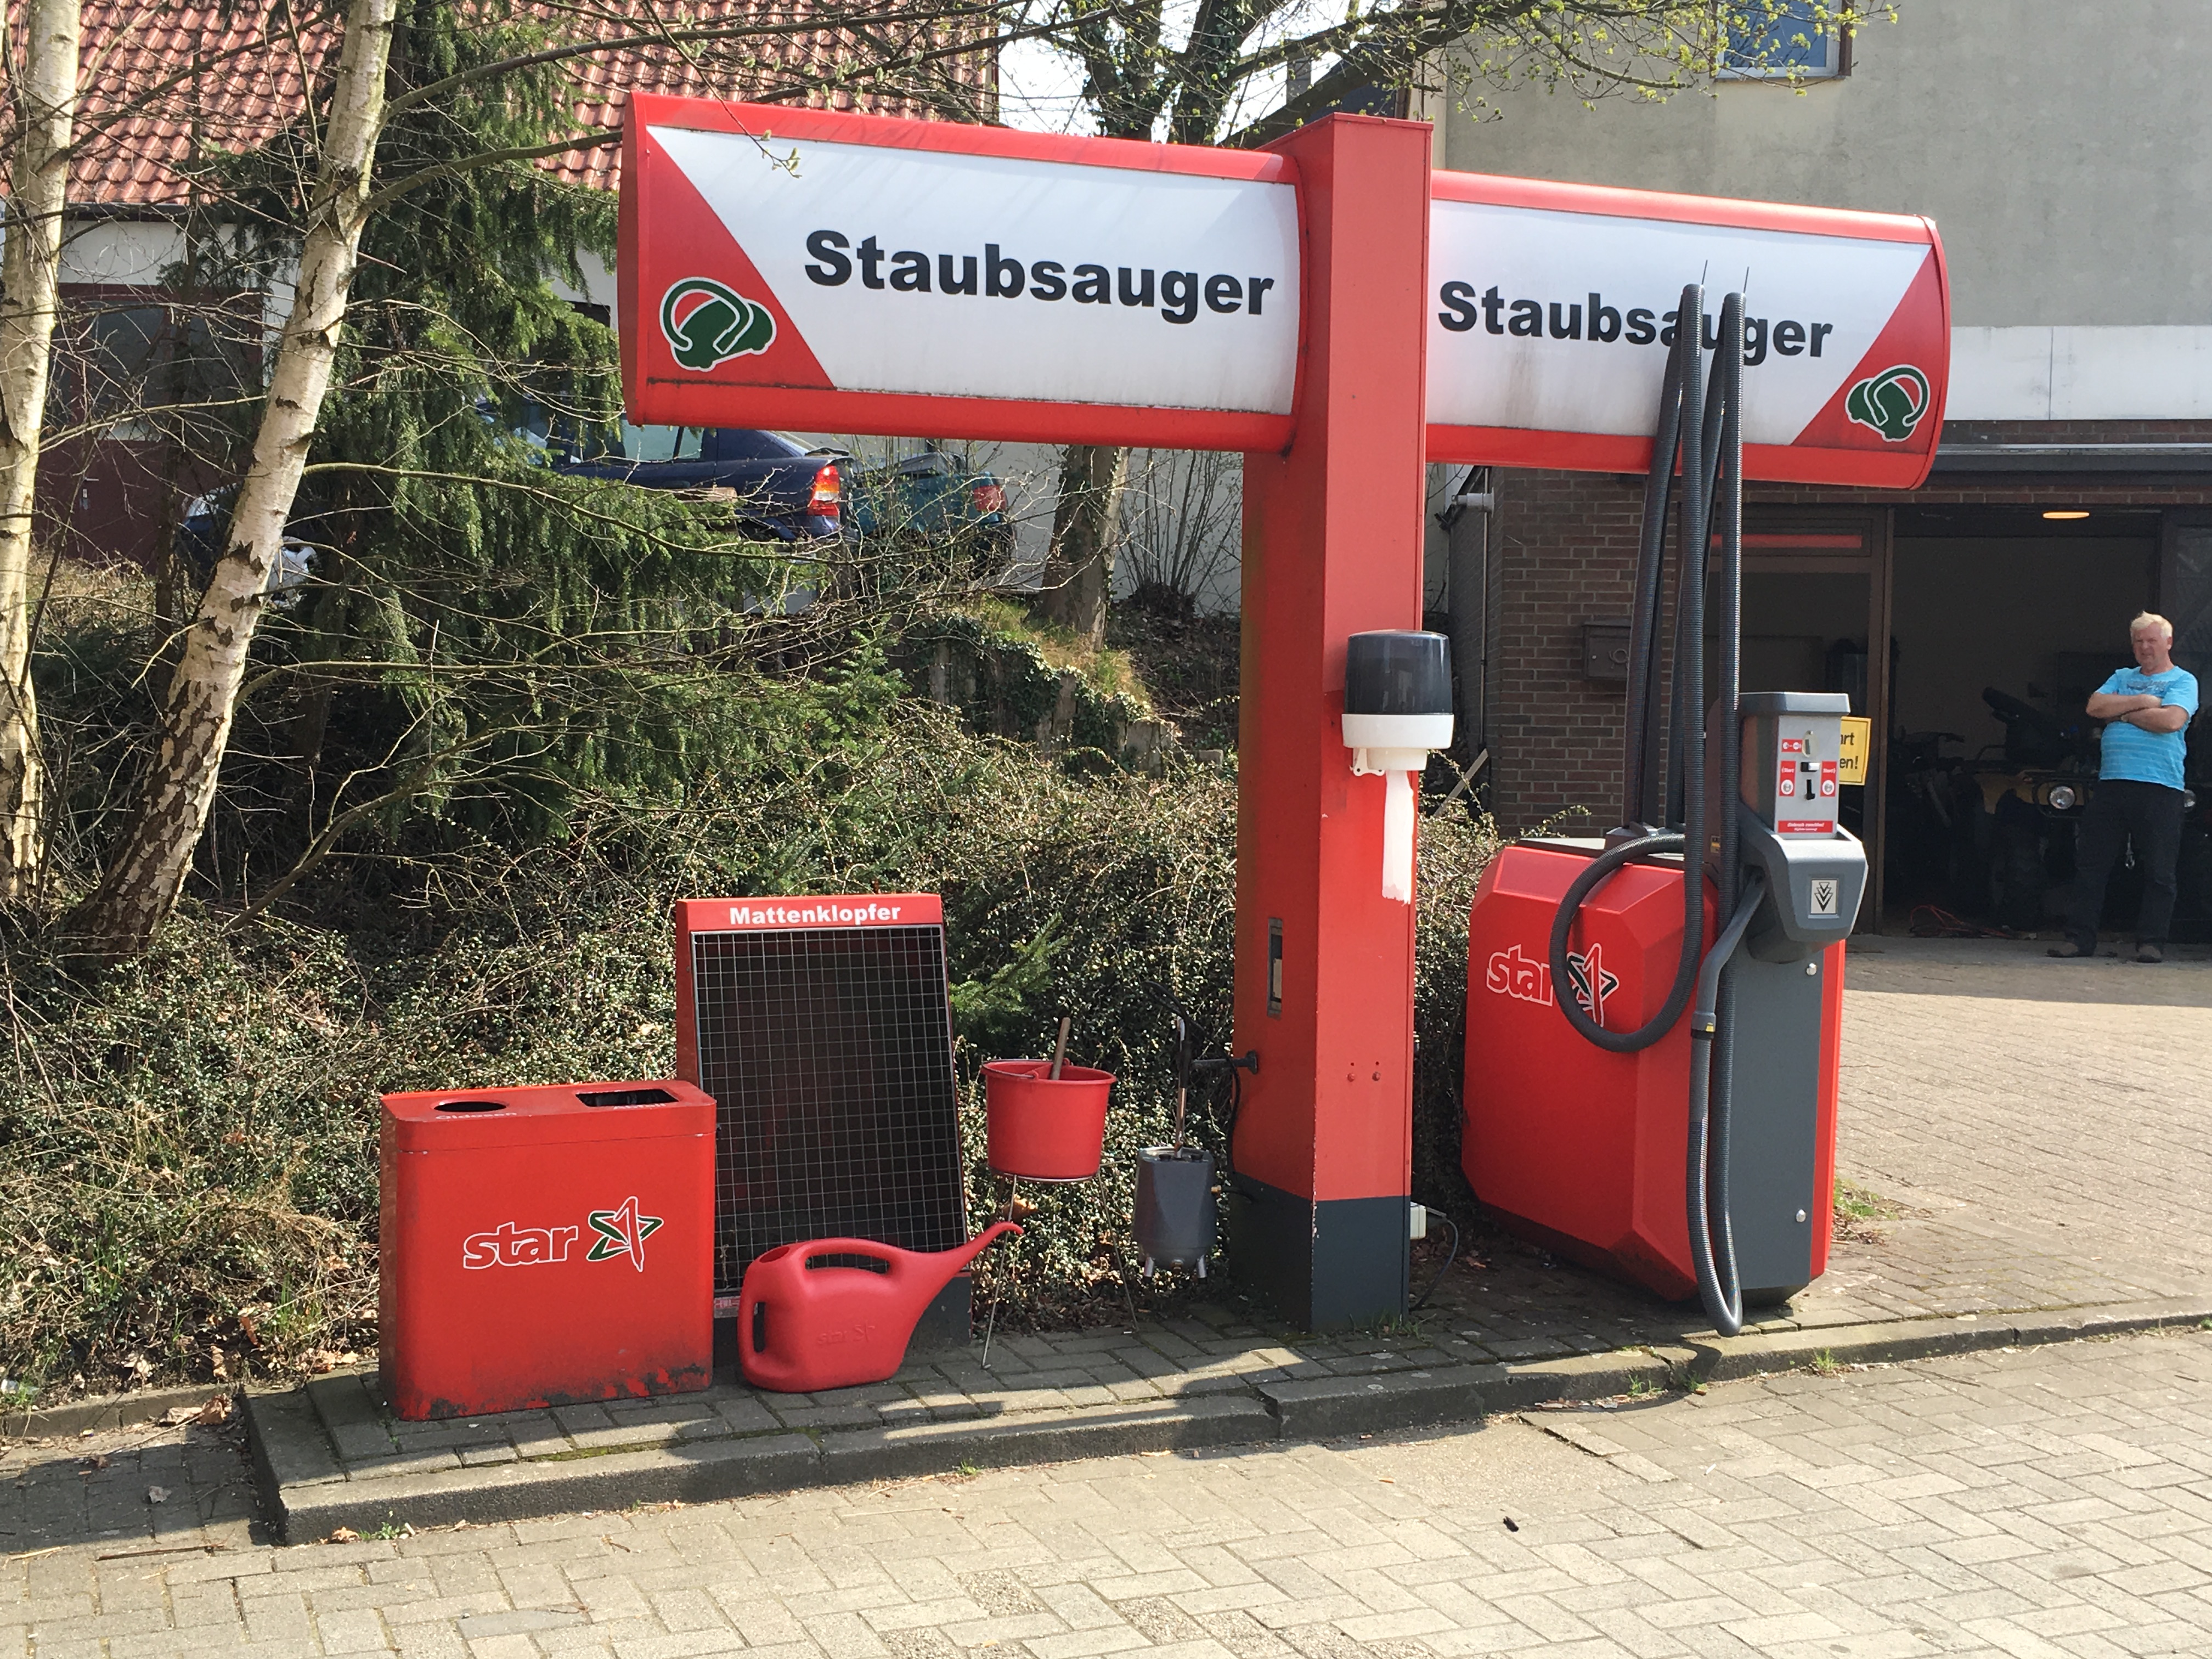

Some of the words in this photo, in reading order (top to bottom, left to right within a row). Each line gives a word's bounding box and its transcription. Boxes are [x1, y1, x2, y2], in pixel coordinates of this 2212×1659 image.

[805, 229, 1274, 325] Staubsauger
[730, 903, 901, 926] Mattenklopfer
[463, 1221, 578, 1269] star
